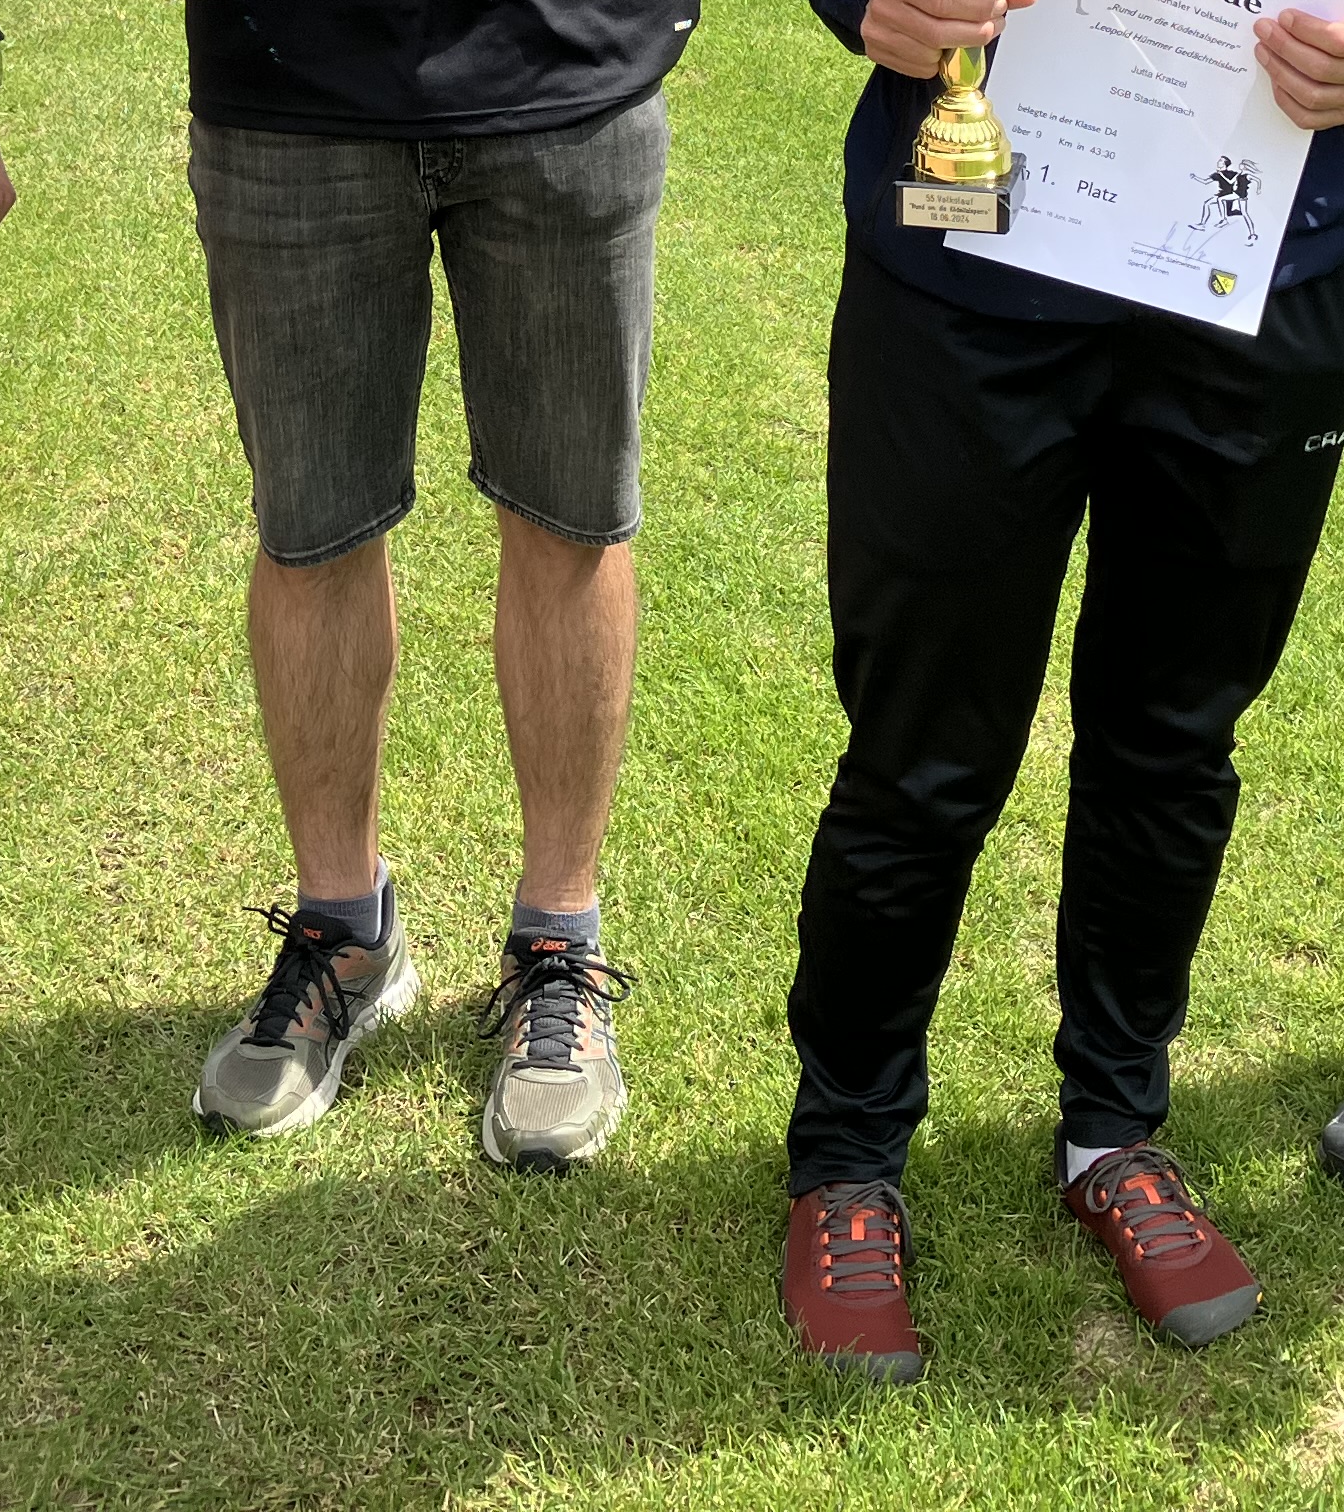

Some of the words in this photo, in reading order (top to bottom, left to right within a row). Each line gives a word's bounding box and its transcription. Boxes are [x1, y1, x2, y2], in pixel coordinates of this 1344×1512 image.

[1138, 12, 1153, 22] um
[1154, 16, 1169, 27] die
[1193, 5, 1239, 30] Volkslauf
[1130, 65, 1153, 79] Jutta
[1109, 86, 1132, 99] SGB
[1017, 102, 1048, 119] belegte
[1049, 111, 1057, 121] in
[1058, 114, 1073, 125] der
[1074, 119, 1101, 134] Klasse
[1104, 126, 1118, 137] D4
[1035, 130, 1042, 139] 9
[1058, 137, 1073, 148] Km
[1076, 141, 1085, 152] in
[1040, 164, 1055, 186] 1.
[1076, 179, 1118, 204] Platz
